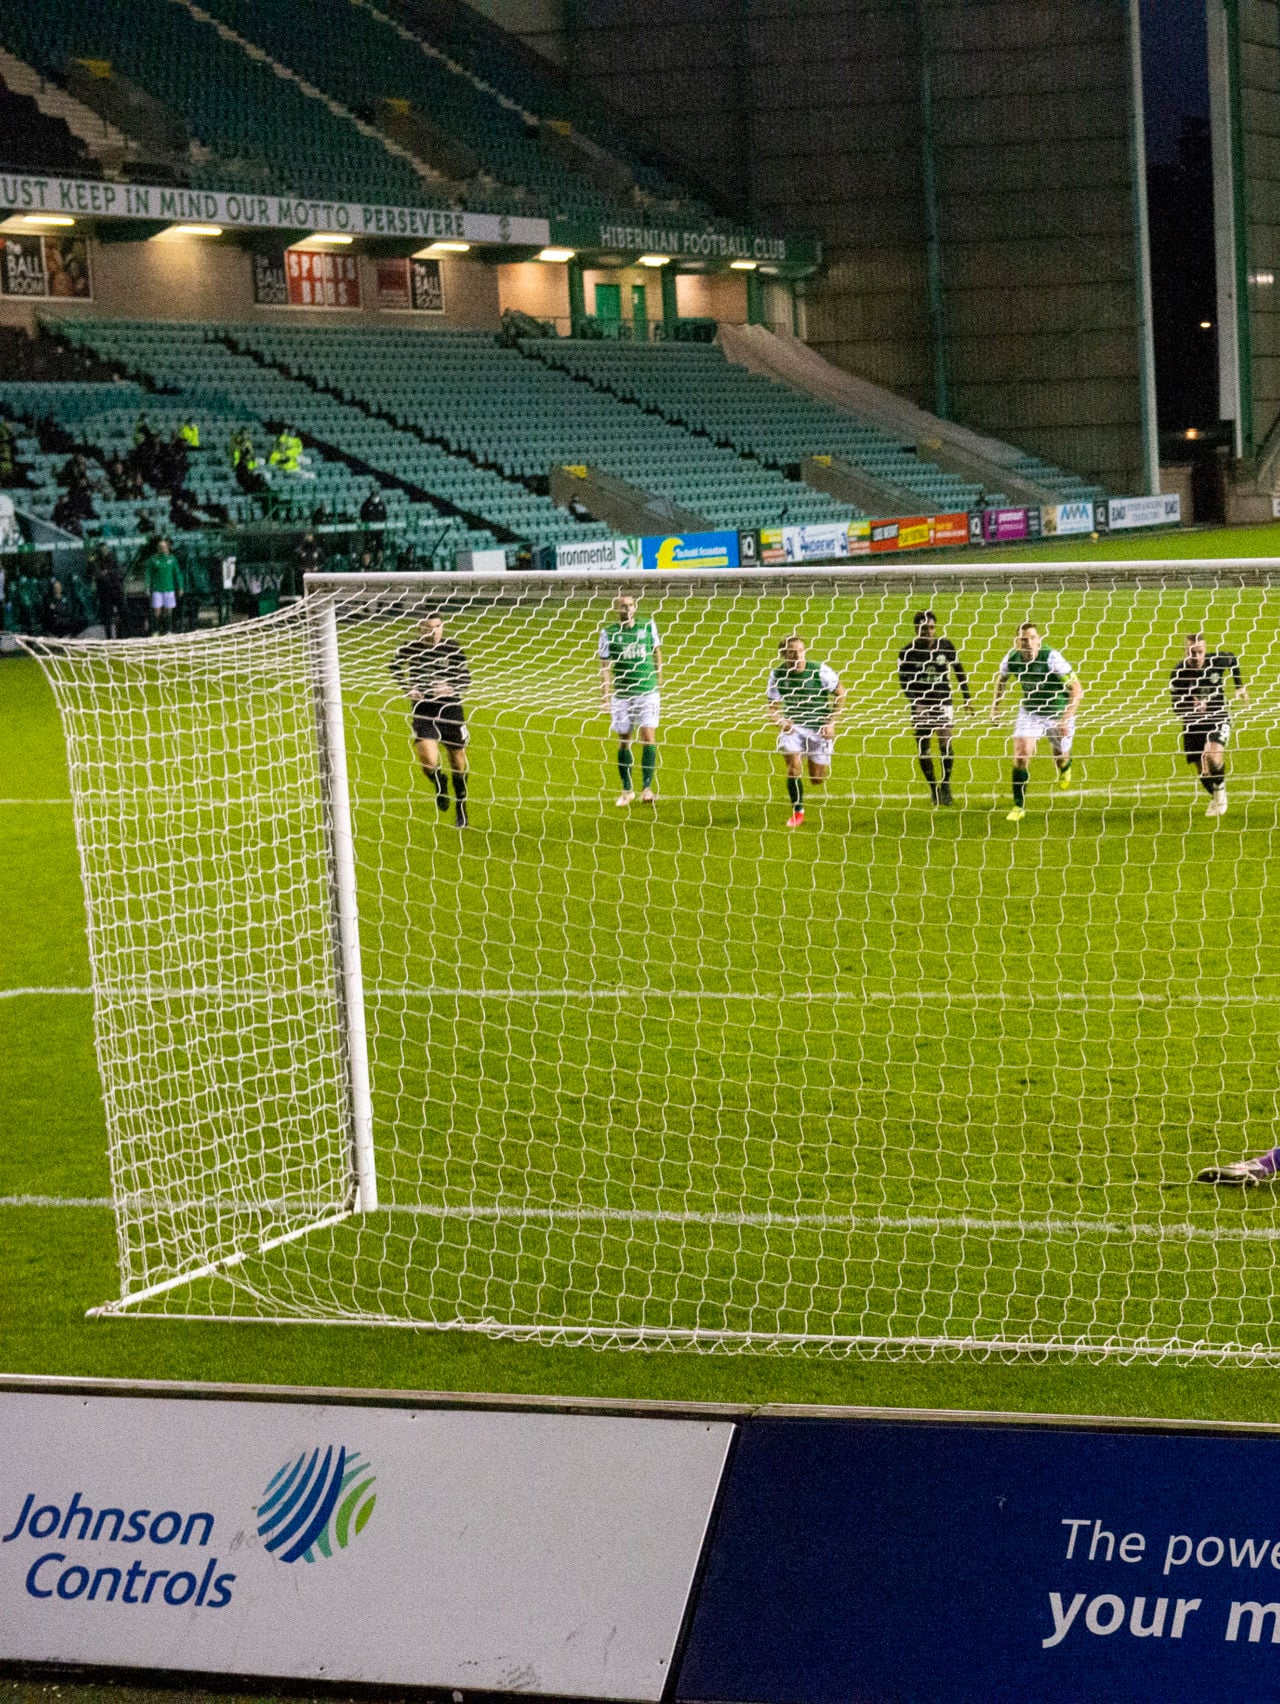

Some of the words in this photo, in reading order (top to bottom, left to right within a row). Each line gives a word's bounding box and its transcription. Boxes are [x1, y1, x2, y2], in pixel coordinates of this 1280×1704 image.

[60, 182, 116, 212] KEEP
[125, 187, 150, 215] IN
[159, 190, 219, 219] MIND
[225, 196, 270, 223] OUR
[362, 206, 466, 237] PERSEVERE
[600, 225, 679, 252] HIBERNIAN
[683, 232, 752, 258] FOOTBALL
[753, 237, 786, 259] CLUB
[7, 254, 43, 278] BALL
[288, 253, 356, 278] SPORTS
[302, 281, 348, 305] BARS
[2, 1492, 215, 1545] Johnson
[1059, 1519, 1147, 1565] The
[25, 1552, 237, 1608] Controls
[1041, 1591, 1203, 1649] your
